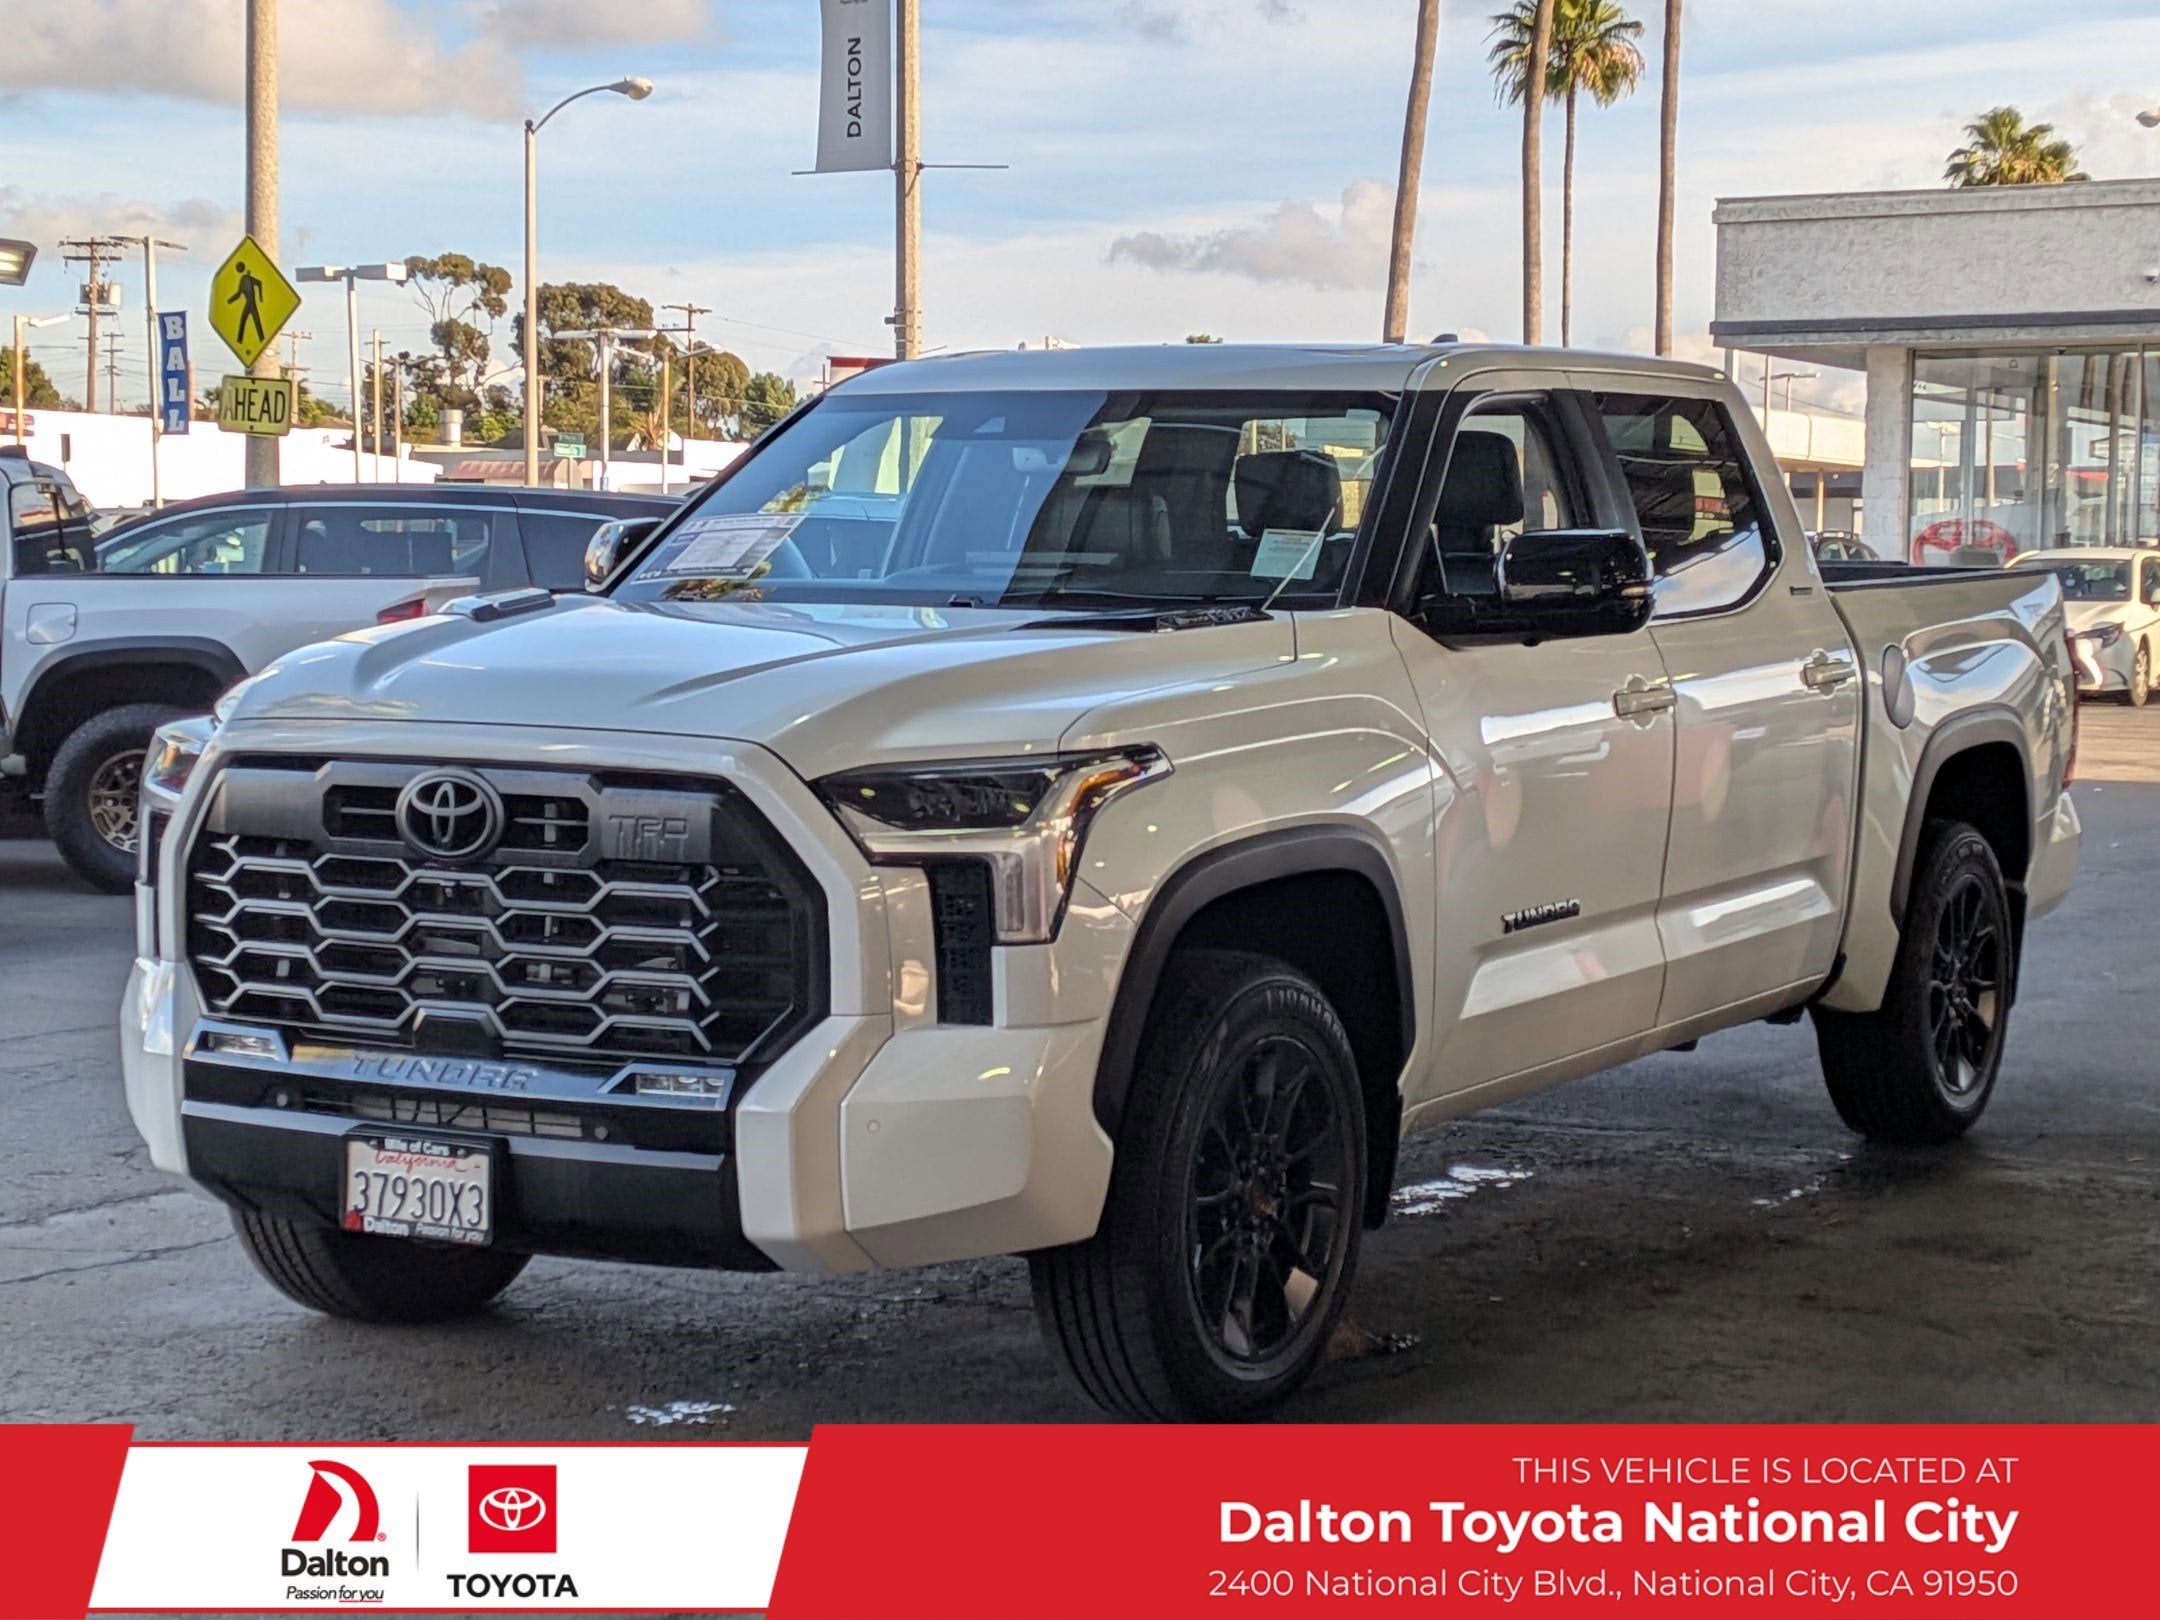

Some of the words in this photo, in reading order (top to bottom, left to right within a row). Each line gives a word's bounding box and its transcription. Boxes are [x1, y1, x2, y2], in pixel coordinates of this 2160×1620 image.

[846, 37, 862, 138] DALTON
[164, 315, 186, 432] BALL
[222, 386, 287, 424] AHEAD
[353, 1170, 484, 1228] 37930X3
[363, 1215, 409, 1236] Dalton
